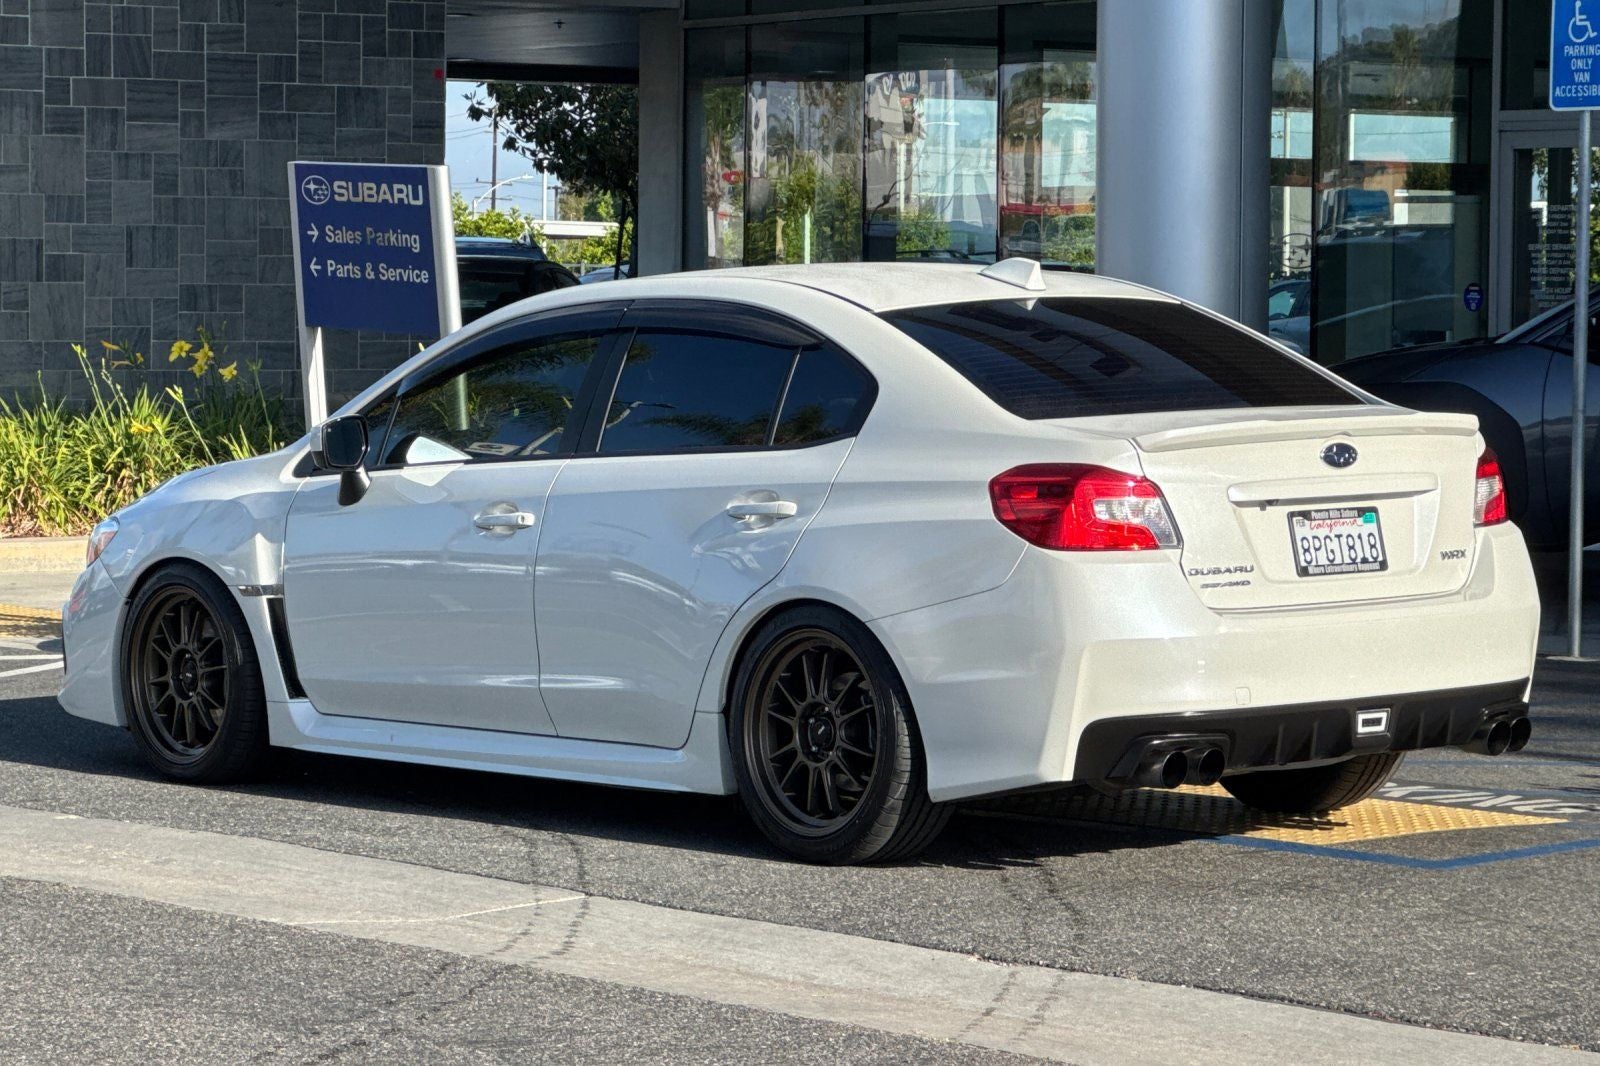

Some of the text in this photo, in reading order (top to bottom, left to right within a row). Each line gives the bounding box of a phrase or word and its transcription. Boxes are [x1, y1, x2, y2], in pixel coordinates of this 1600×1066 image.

[1564, 44, 1600, 57] PARKING
[1571, 58, 1593, 70] ONLY
[1573, 72, 1590, 83] VAN
[333, 181, 423, 206] SUBARU
[325, 225, 420, 253] Sales Parking
[327, 259, 429, 283] Parts & Service
[1309, 518, 1363, 533] California
[1300, 532, 1380, 565] 8PGT818
[1440, 549, 1466, 560] WRX
